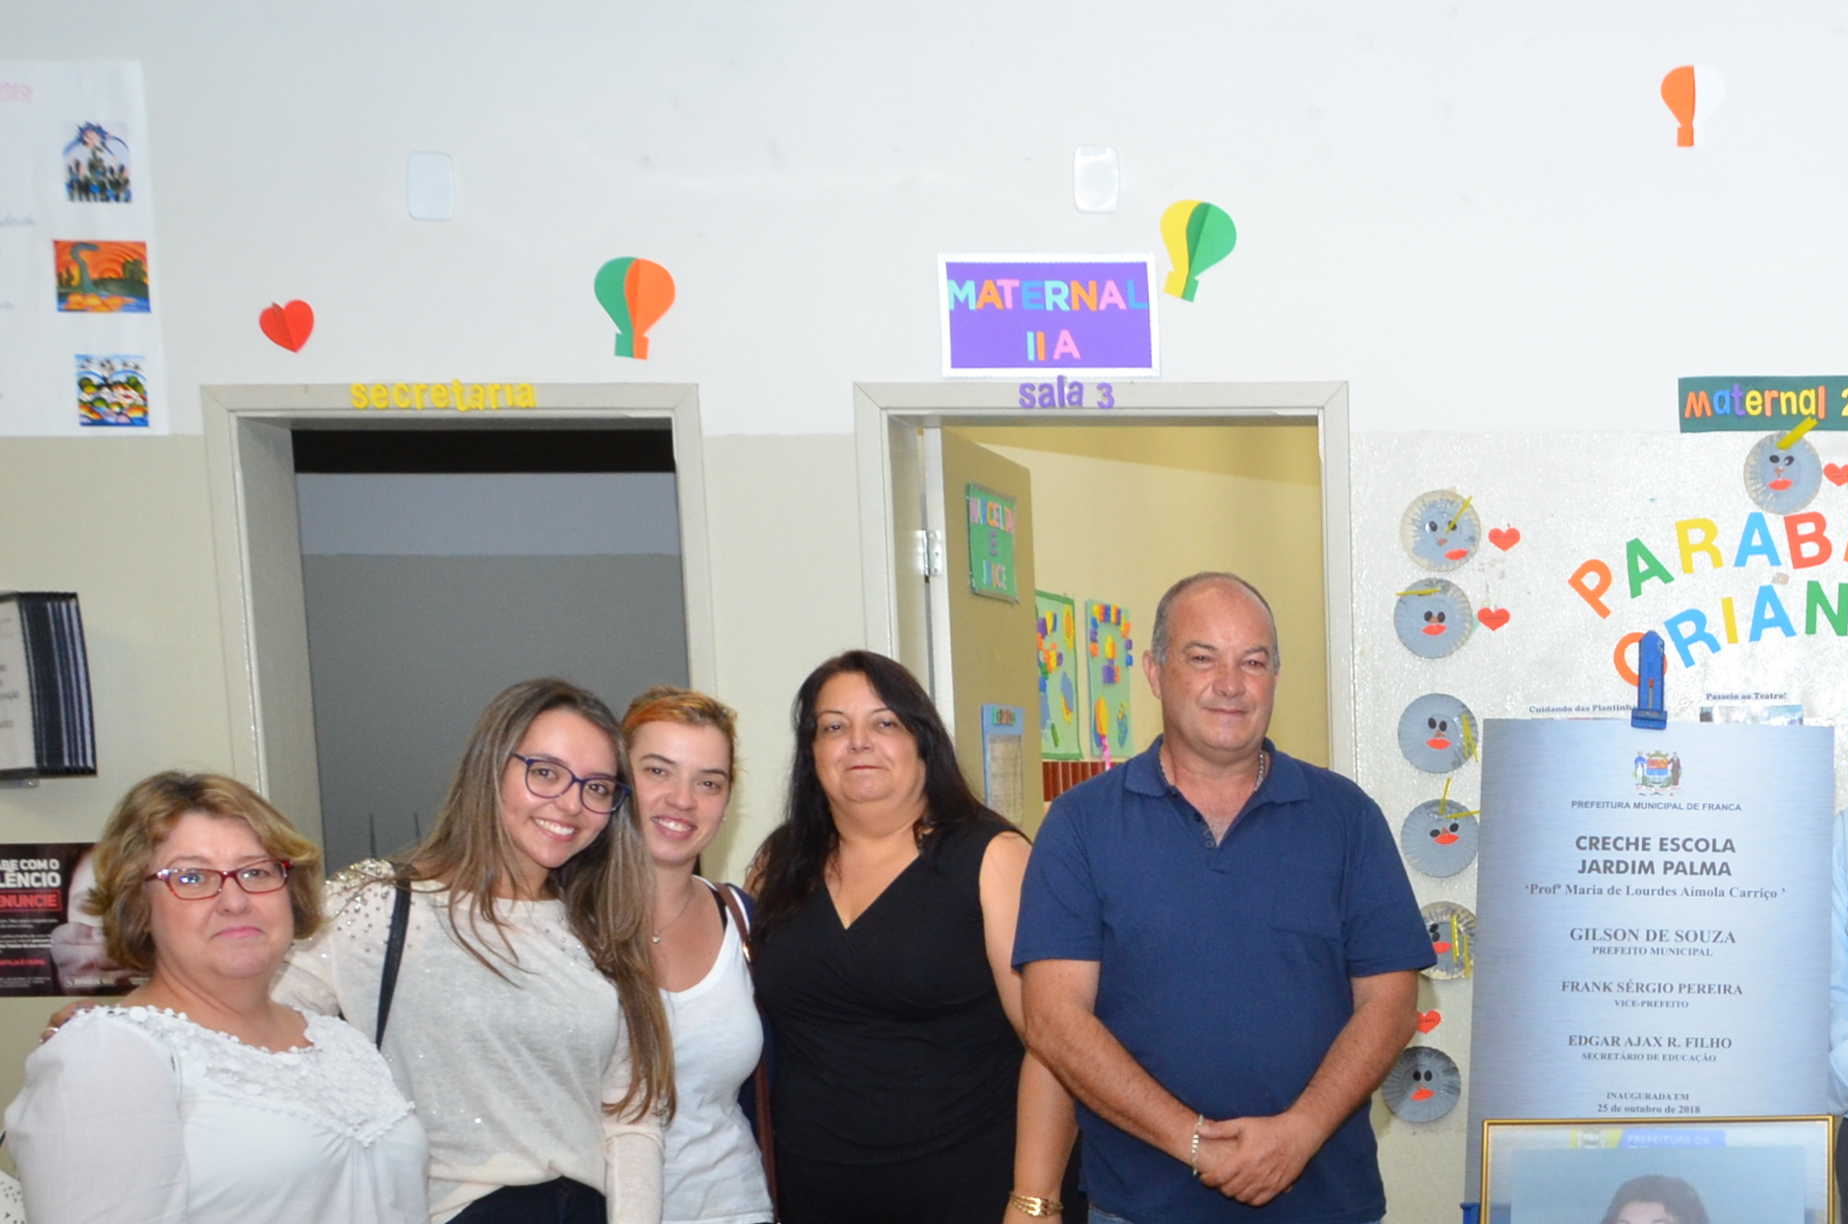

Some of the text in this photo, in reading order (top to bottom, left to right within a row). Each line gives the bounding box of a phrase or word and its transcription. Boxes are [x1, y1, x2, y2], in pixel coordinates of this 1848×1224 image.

[947, 279, 1149, 311] MATERNAL
[1053, 329, 1081, 360] A
[351, 378, 535, 412] secretaria
[1018, 375, 1115, 409] sala 3
[1706, 692, 1738, 700] Passeio
[1754, 692, 1787, 700] Teatro!
[1528, 705, 1572, 713] Cuidando
[1571, 801, 1742, 812] PREFEITURA MUNICIPAL DE FRANCA
[1575, 836, 1736, 853] CRECHE ESCOLA
[0, 859, 60, 870] BE COM O
[1577, 859, 1732, 877] JARDIM PALMA
[1565, 885, 1602, 896] Maria
[1607, 886, 1622, 896] de
[1625, 886, 1678, 898] Lourdes
[1569, 928, 1736, 944] GILSON DE SOUZA
[1592, 946, 1713, 957] PREFEITO MUNICIPAL
[1561, 979, 1743, 995] FRANK SÉRGIO PEREIRA
[1614, 1000, 1689, 1009] VICE-PREFEITO
[1568, 1035, 1732, 1049] EDGAR AJAX R. FILHO
[1582, 1052, 1717, 1064] SECRETÁRIO DE EDUCAÇÃO
[1606, 1092, 1690, 1101] INAUGURADA EM
[1597, 1103, 1701, 1115] 25 de outubro de 2018
